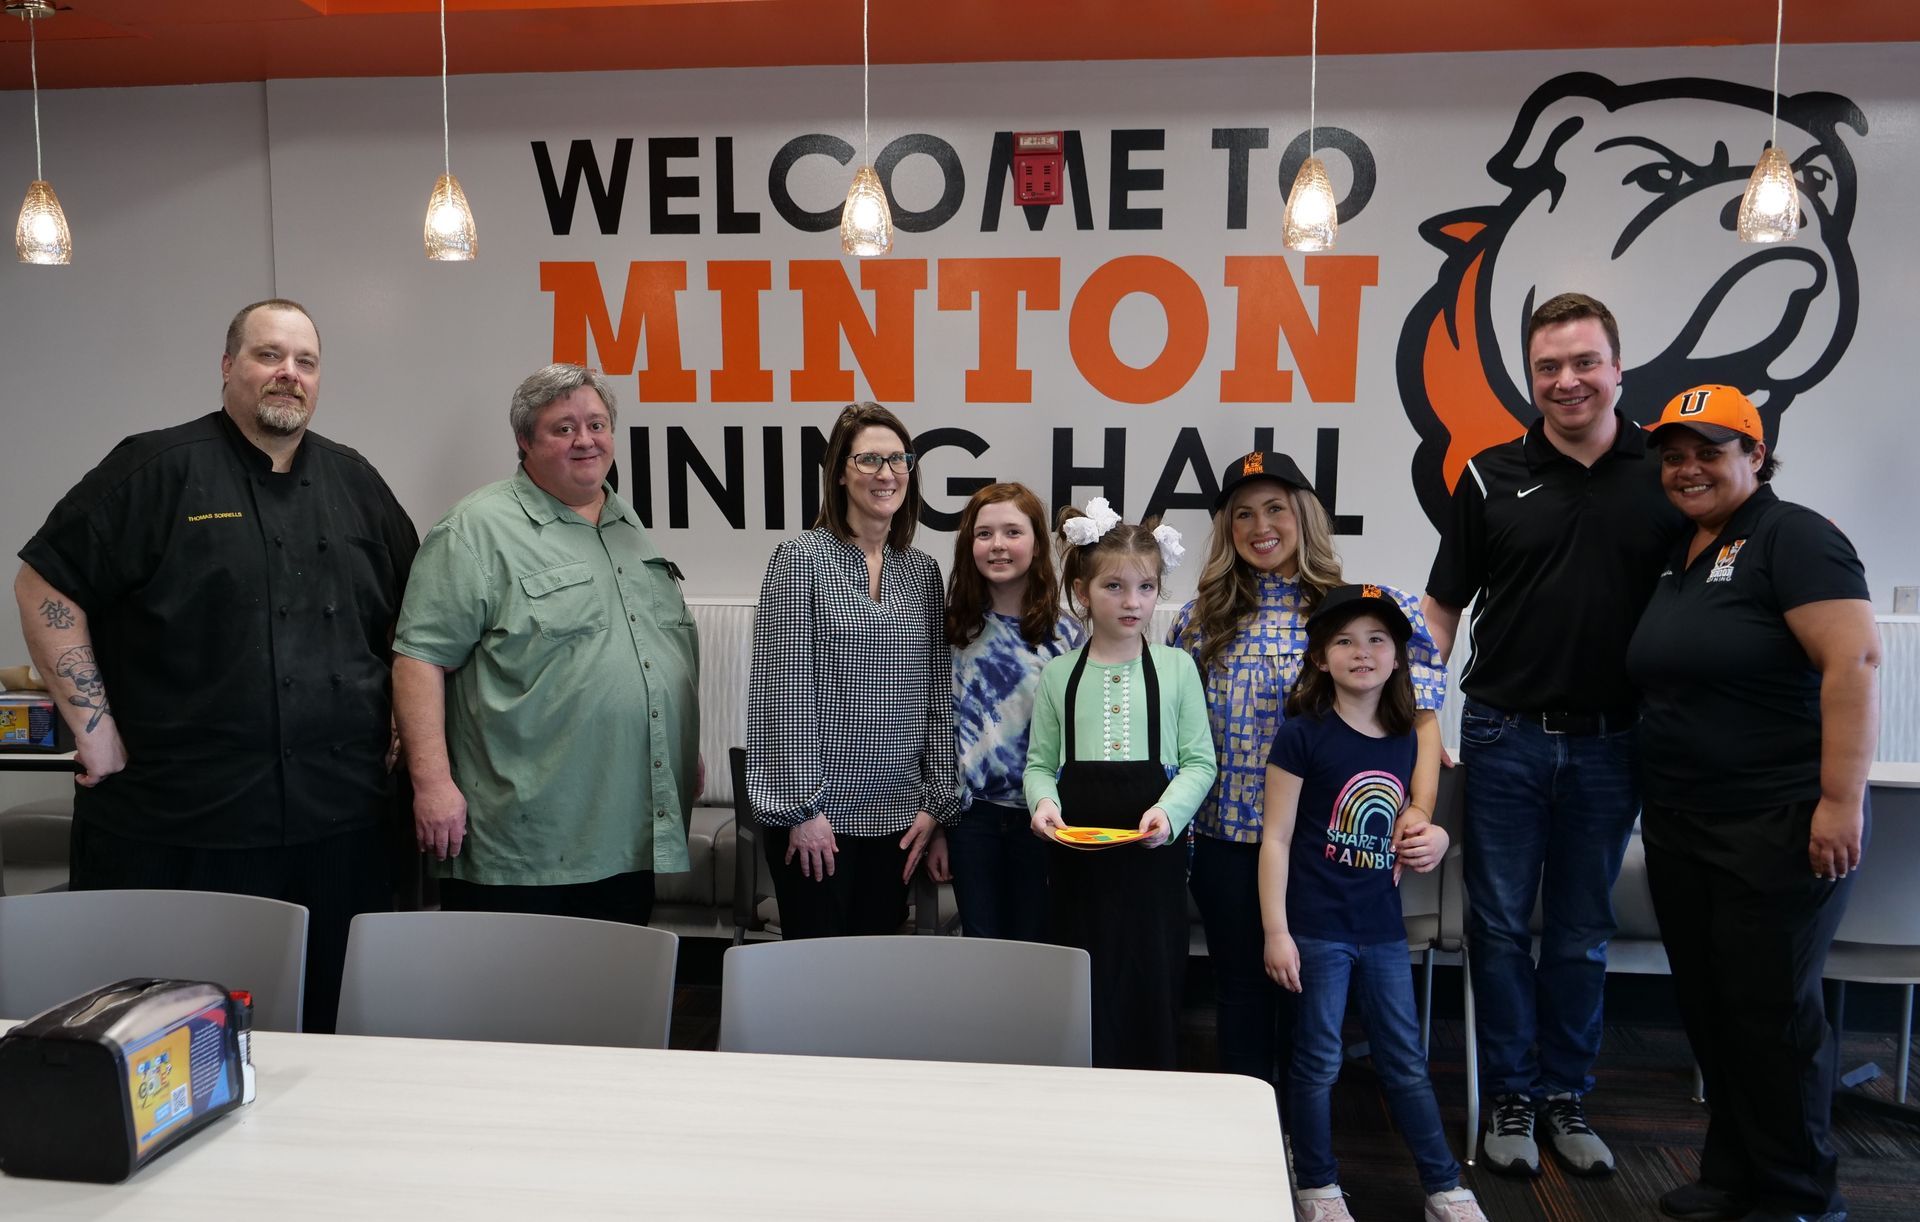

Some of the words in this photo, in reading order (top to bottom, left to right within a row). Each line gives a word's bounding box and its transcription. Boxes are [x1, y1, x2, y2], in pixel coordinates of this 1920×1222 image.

[531, 129, 1165, 235] WELCOME
[1211, 127, 1377, 229] TO
[540, 255, 1379, 404] MINTON
[1679, 390, 1711, 416] U
[1051, 427, 1363, 536] HAL
[188, 513, 213, 522] THOMAS
[214, 511, 242, 519] SORRELLS
[1326, 828, 1377, 850] SHARE
[1325, 843, 1395, 870] RAINBO
